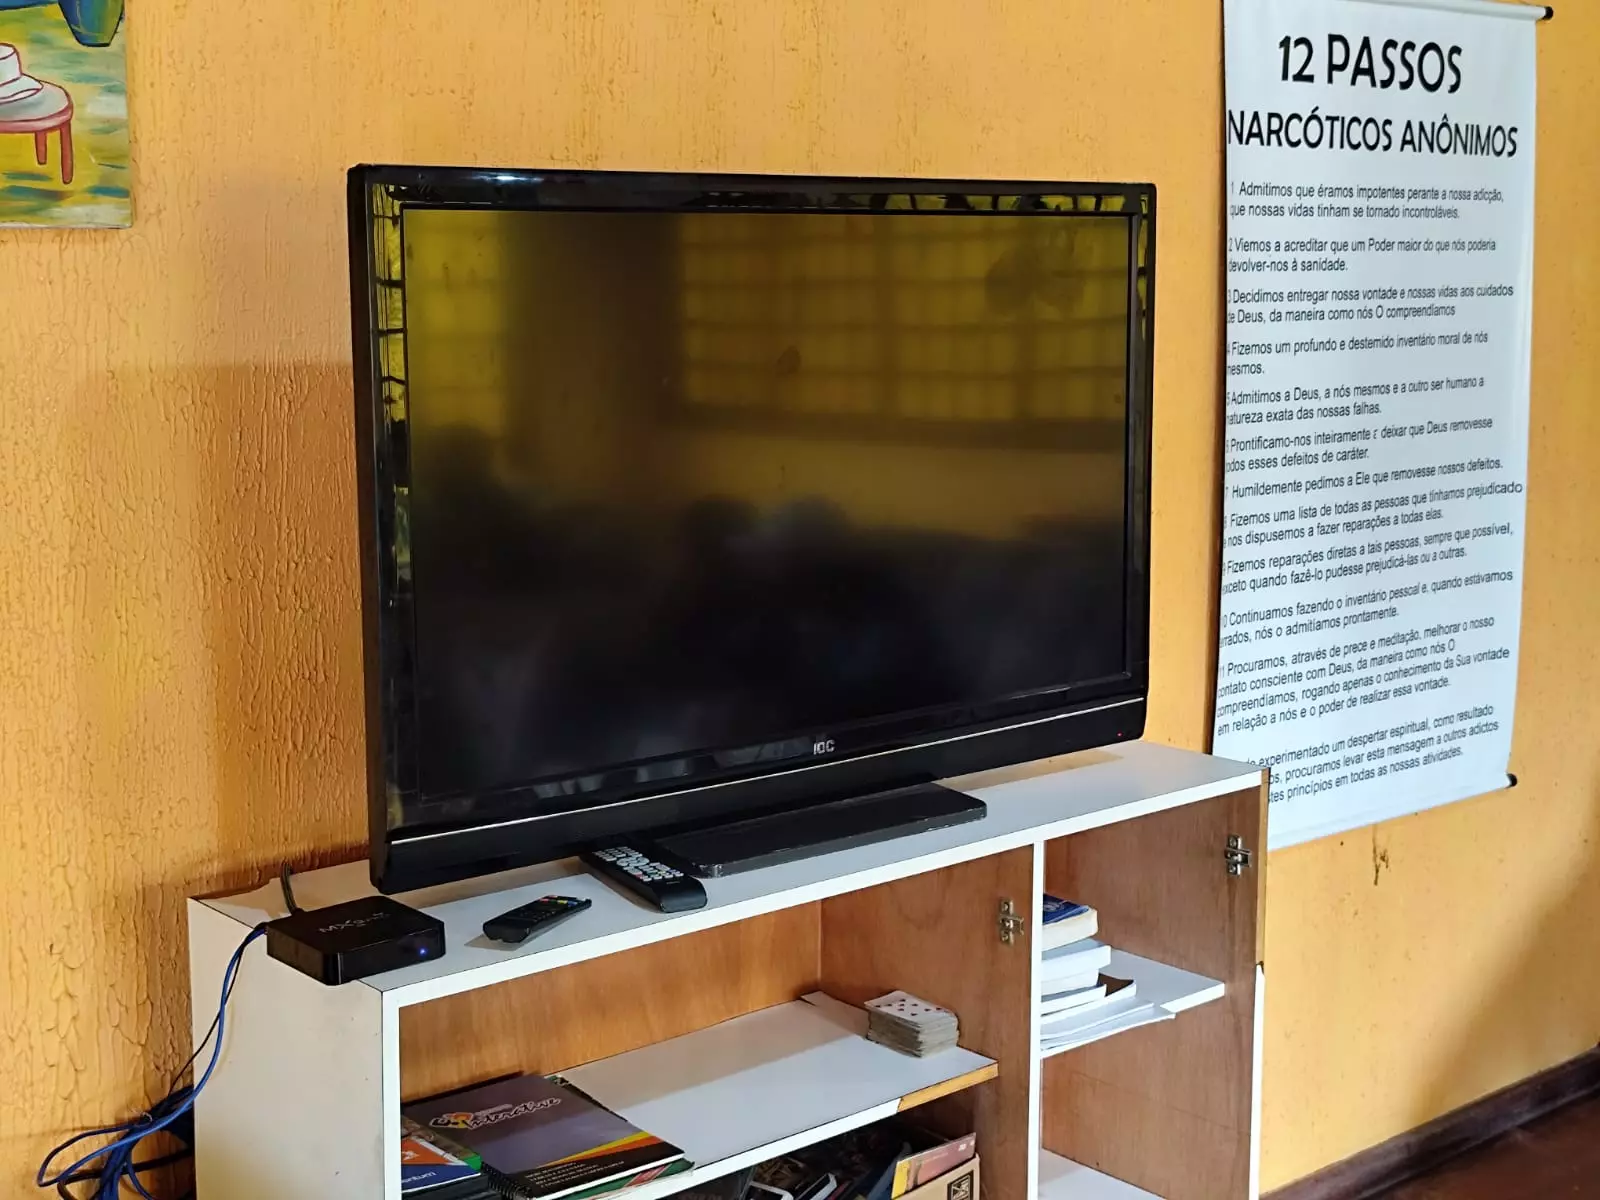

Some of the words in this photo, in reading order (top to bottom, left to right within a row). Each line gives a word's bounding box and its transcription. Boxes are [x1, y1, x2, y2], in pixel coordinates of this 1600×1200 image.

[1278, 34, 1314, 84] 12
[1326, 33, 1463, 94] PASSOS
[1228, 106, 1392, 152] NARCÓTICOS
[1400, 114, 1519, 158] ANÔNIMOS
[1239, 181, 1293, 197] Admitimos
[1295, 186, 1315, 200] que
[1317, 184, 1354, 198] éramos
[1356, 184, 1405, 202] impotentes
[1407, 187, 1439, 202] perante
[1449, 190, 1471, 201] nossa
[1248, 205, 1285, 217] nossas
[1288, 203, 1314, 217] vidas
[1317, 203, 1350, 217] tinham
[1353, 206, 1364, 218] se
[1366, 204, 1400, 218] tornado
[1234, 237, 1272, 252] Viemos
[1284, 238, 1328, 252] acreditar
[1330, 241, 1349, 255] que
[1351, 241, 1366, 252] um
[1368, 237, 1396, 252] Poder
[1397, 238, 1422, 252] maior
[1435, 241, 1450, 253] que
[1451, 238, 1466, 251] nós
[1467, 239, 1496, 254] poderia
[1300, 257, 1348, 272] sanidade.
[1233, 289, 1284, 304] Decidimos
[1287, 289, 1329, 305] entregar
[1331, 290, 1360, 301] nossa
[1362, 287, 1398, 300] vontade
[1407, 288, 1436, 299] nossas
[1437, 285, 1459, 298] vidas
[1460, 287, 1475, 297] aos
[1476, 284, 1514, 297] cuidados
[1237, 309, 1266, 324] Deus,
[1269, 308, 1282, 322] da
[1285, 307, 1325, 322] maneira
[1328, 309, 1355, 320] como
[1357, 305, 1374, 319] nós
[1232, 341, 1272, 356] Fizemos
[1275, 342, 1291, 354] um
[1294, 337, 1337, 356] profundo
[1348, 336, 1394, 350] destemido
[1437, 332, 1460, 345] moral
[1474, 330, 1488, 343] nós
[1231, 390, 1281, 405] Admitimos
[1293, 387, 1321, 401] Deus,
[1333, 384, 1351, 398] nós
[1353, 384, 1391, 397] mesmos
[1408, 380, 1429, 393] outro
[1430, 380, 1444, 391] ser
[1446, 377, 1477, 389] humano
[1266, 408, 1294, 422] exata
[1296, 406, 1314, 420] das
[1317, 405, 1351, 418] nossas
[1353, 401, 1381, 415] falhas.
[1231, 435, 1312, 452] Prontificamo-nos
[1314, 428, 1371, 445] inteiramente
[1381, 425, 1407, 439] deixar
[1409, 425, 1425, 438] que
[1427, 420, 1448, 434] Deus
[1449, 418, 1493, 432] removesse
[1248, 457, 1278, 470] esses
[1281, 452, 1319, 467] defeitos
[1321, 449, 1334, 463] de
[1336, 447, 1369, 462] caráter.
[1232, 480, 1303, 498] Humildemente
[1305, 476, 1345, 494] pedimos
[1355, 471, 1370, 485] Ele
[1372, 472, 1389, 486] que
[1391, 466, 1436, 481] removesse
[1437, 462, 1465, 476] nossos
[1466, 458, 1503, 472] defeitos.
[1231, 513, 1271, 527] Fizemos
[1273, 510, 1295, 522] uma
[1298, 506, 1317, 519] lista
[1319, 504, 1332, 517] de
[1334, 501, 1359, 515] todas
[1374, 496, 1410, 513] pessoas
[1411, 493, 1427, 507] que
[1466, 481, 1523, 500] prejudicado
[1228, 535, 1243, 547] nos
[1245, 527, 1305, 546] dispusemos
[1316, 522, 1341, 536] fazer
[1342, 515, 1391, 534] reparações
[1400, 510, 1424, 524] todas
[1228, 558, 1266, 573] Fizemos
[1269, 550, 1324, 570] reparações
[1326, 546, 1357, 560] diretas
[1367, 540, 1382, 555] tais
[1423, 532, 1452, 546] sempre
[1454, 529, 1471, 543] que
[1249, 572, 1287, 592] quando
[1290, 568, 1323, 584] fazê-lo
[1325, 563, 1364, 582] pudesse
[1365, 553, 1419, 576] prejudicá-las
[1438, 547, 1467, 560] outras.
[1229, 606, 1293, 626] Continuamos
[1296, 598, 1334, 615] fazendo
[1389, 582, 1420, 603] pessoal
[1431, 576, 1463, 594] quando
[1464, 571, 1513, 586] estávamos
[1255, 626, 1273, 640] nós
[1343, 606, 1399, 629] prontamente.
[1227, 656, 1288, 676] Procuramos,
[1329, 645, 1341, 658] de
[1343, 641, 1368, 658] prece
[1424, 623, 1461, 639] melhorar
[1469, 617, 1495, 629] nosso
[1249, 670, 1303, 691] consciente
[1305, 667, 1326, 681] com
[1328, 662, 1354, 676] Deus,
[1370, 651, 1403, 668] maneira
[1405, 646, 1428, 660] como
[1430, 641, 1446, 654] nós
[1301, 681, 1340, 701] rogando
[1342, 676, 1374, 694] apenas
[1383, 660, 1442, 682] conhecimento
[1455, 654, 1471, 667] Sua
[1473, 647, 1510, 663] vontade
[1218, 723, 1230, 736] em
[1232, 713, 1268, 732] relação
[1279, 708, 1298, 722] nós
[1318, 698, 1345, 718] poder
[1346, 695, 1358, 708] de
[1360, 689, 1392, 705] realizar
[1393, 684, 1412, 698] essa
[1332, 740, 1345, 752] um
[1347, 729, 1388, 748] despertar
[1433, 714, 1455, 729] como
[1456, 704, 1494, 722] resultado
[1285, 759, 1341, 784] procuramos
[1343, 747, 1365, 767] levar
[1366, 748, 1385, 762] esta
[1387, 737, 1435, 756] mensagem
[1443, 728, 1467, 743] outros
[1335, 775, 1348, 787] em
[1350, 768, 1375, 783] todas
[1389, 757, 1420, 773] nossas
